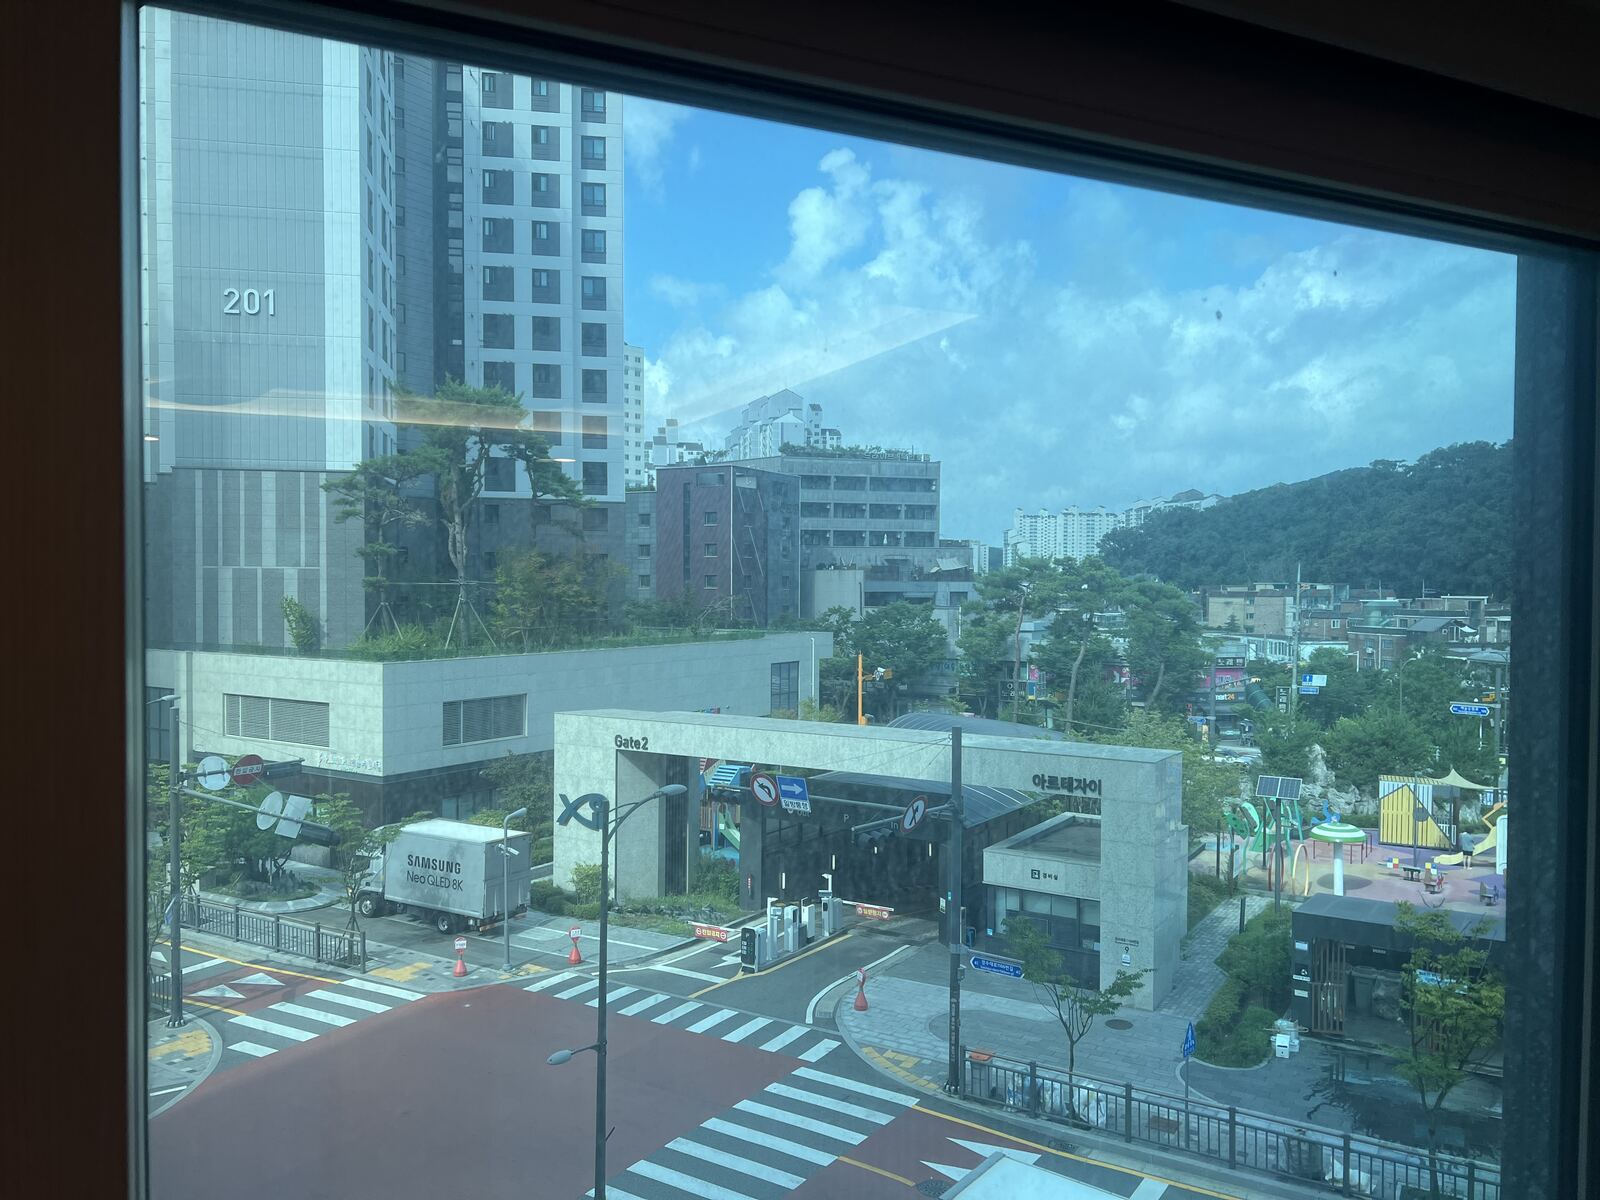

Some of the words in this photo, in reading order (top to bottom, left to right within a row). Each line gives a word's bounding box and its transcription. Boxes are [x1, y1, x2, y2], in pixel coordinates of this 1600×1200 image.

[223, 287, 276, 316] 201
[614, 734, 649, 751] Gate2
[1032, 773, 1102, 796] 아르테자이
[407, 854, 462, 875] SAMSUNG
[406, 870, 425, 884] Neo
[426, 873, 451, 889] QLED
[451, 878, 464, 892] 8K
[1124, 946, 1130, 954] 9
